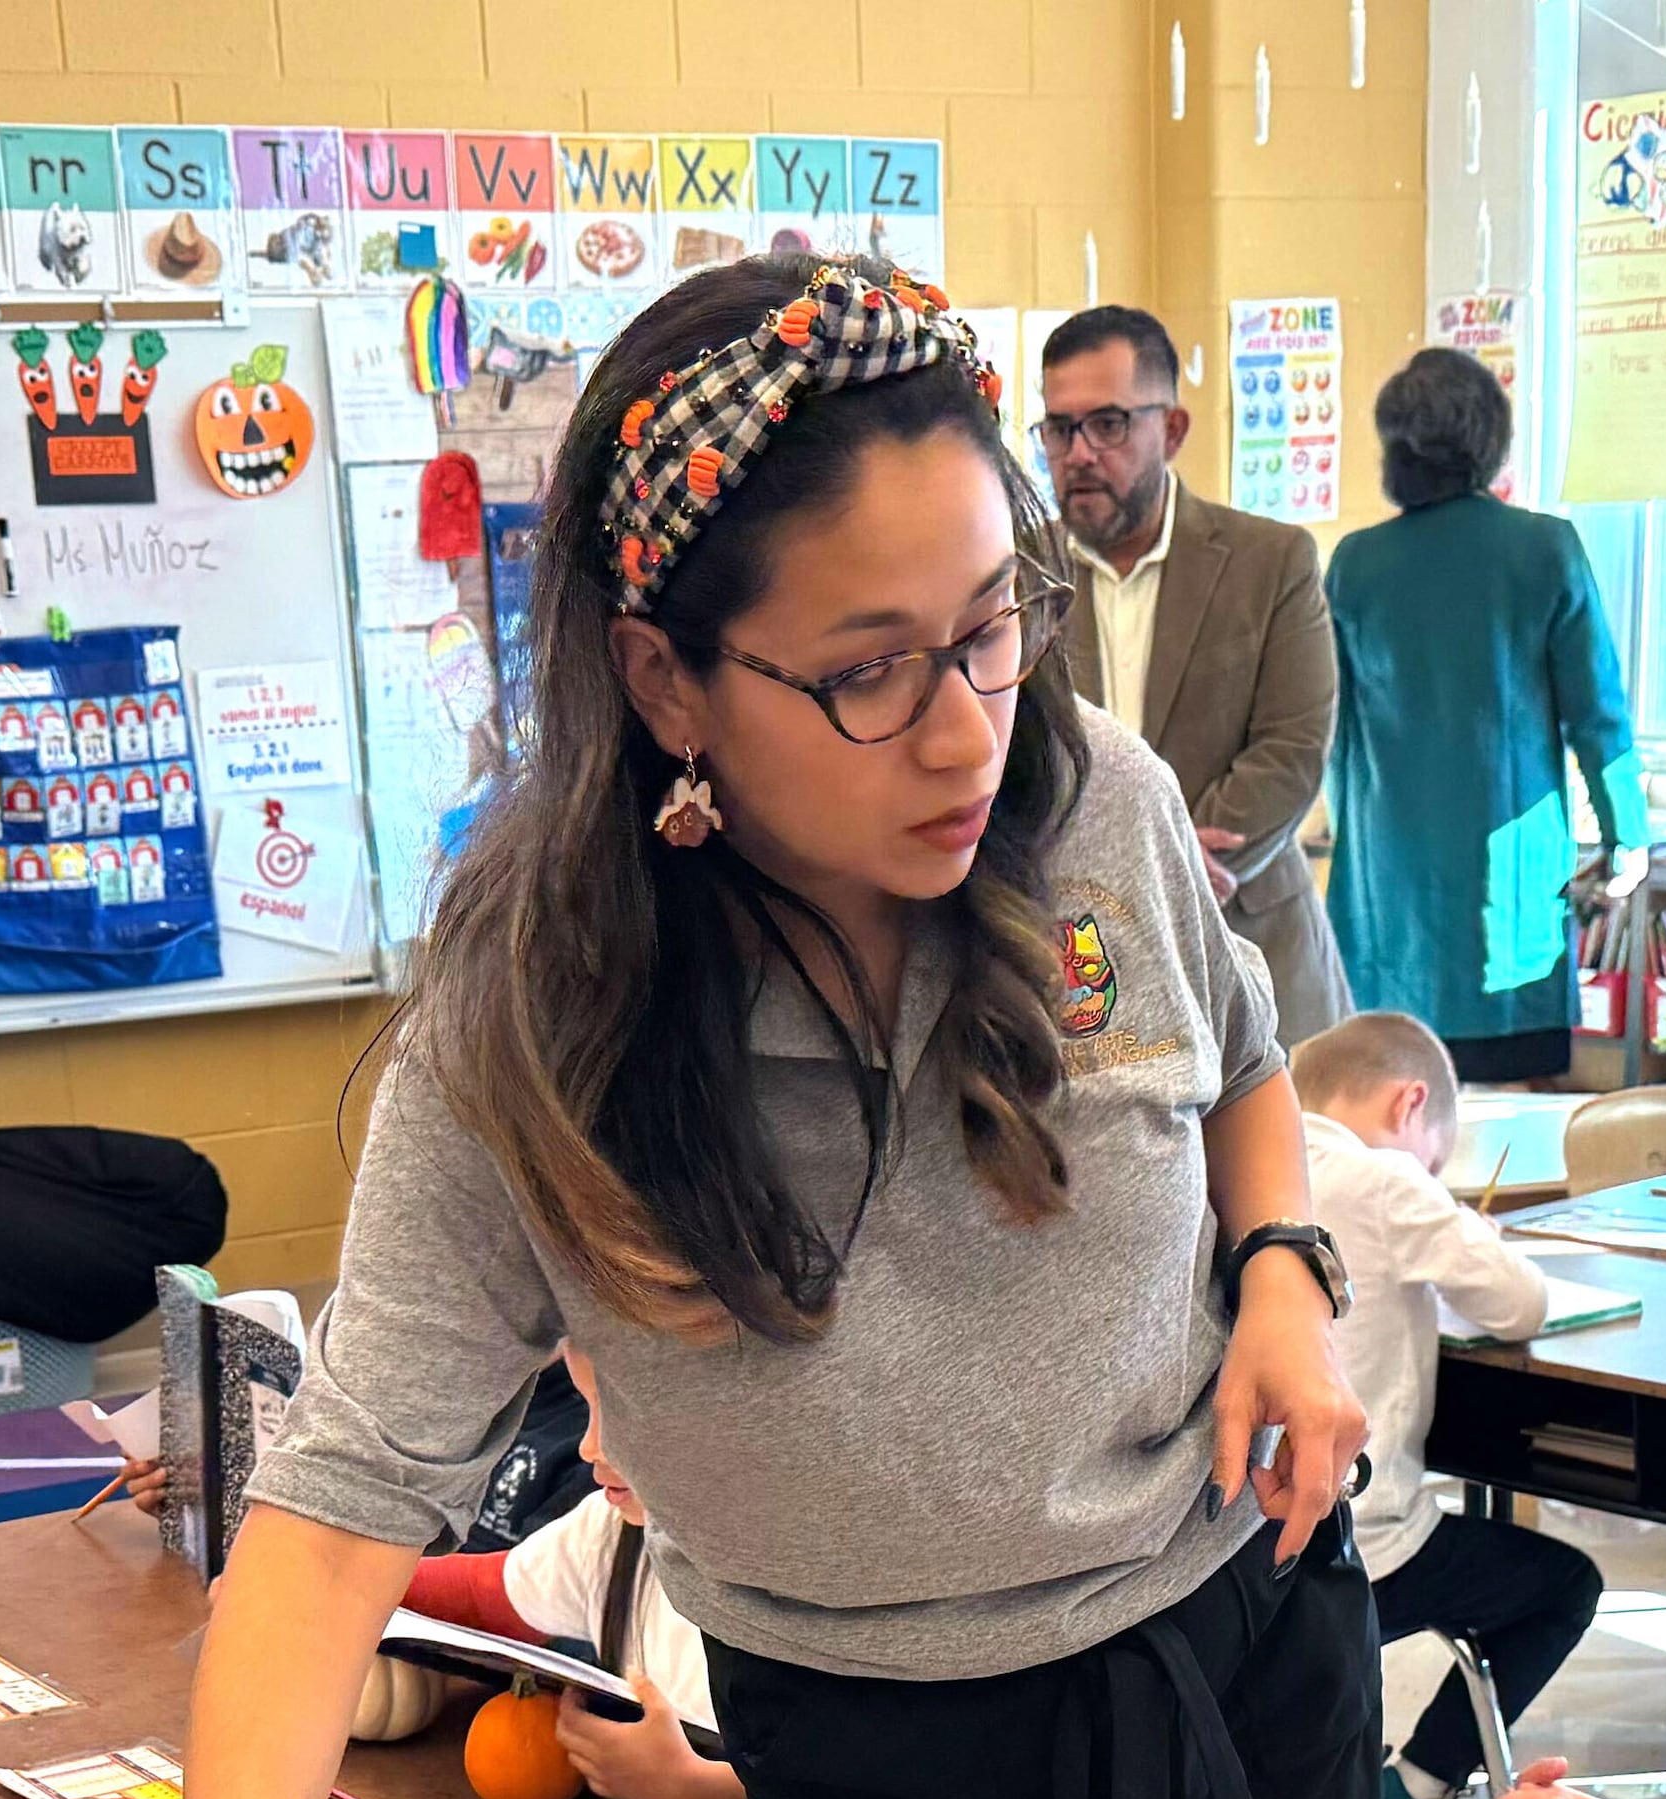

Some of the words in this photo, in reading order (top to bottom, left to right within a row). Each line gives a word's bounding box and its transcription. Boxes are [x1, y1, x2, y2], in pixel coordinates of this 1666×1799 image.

[28, 152, 86, 195] rr
[142, 138, 207, 200] Ss
[259, 138, 316, 199] Tt
[364, 142, 432, 202] Uu
[467, 144, 537, 202] Vv
[562, 147, 653, 206] Ww
[675, 149, 737, 206] Xx
[771, 147, 831, 218] Yy
[866, 151, 919, 208] Zz
[1269, 304, 1334, 332] ZONE
